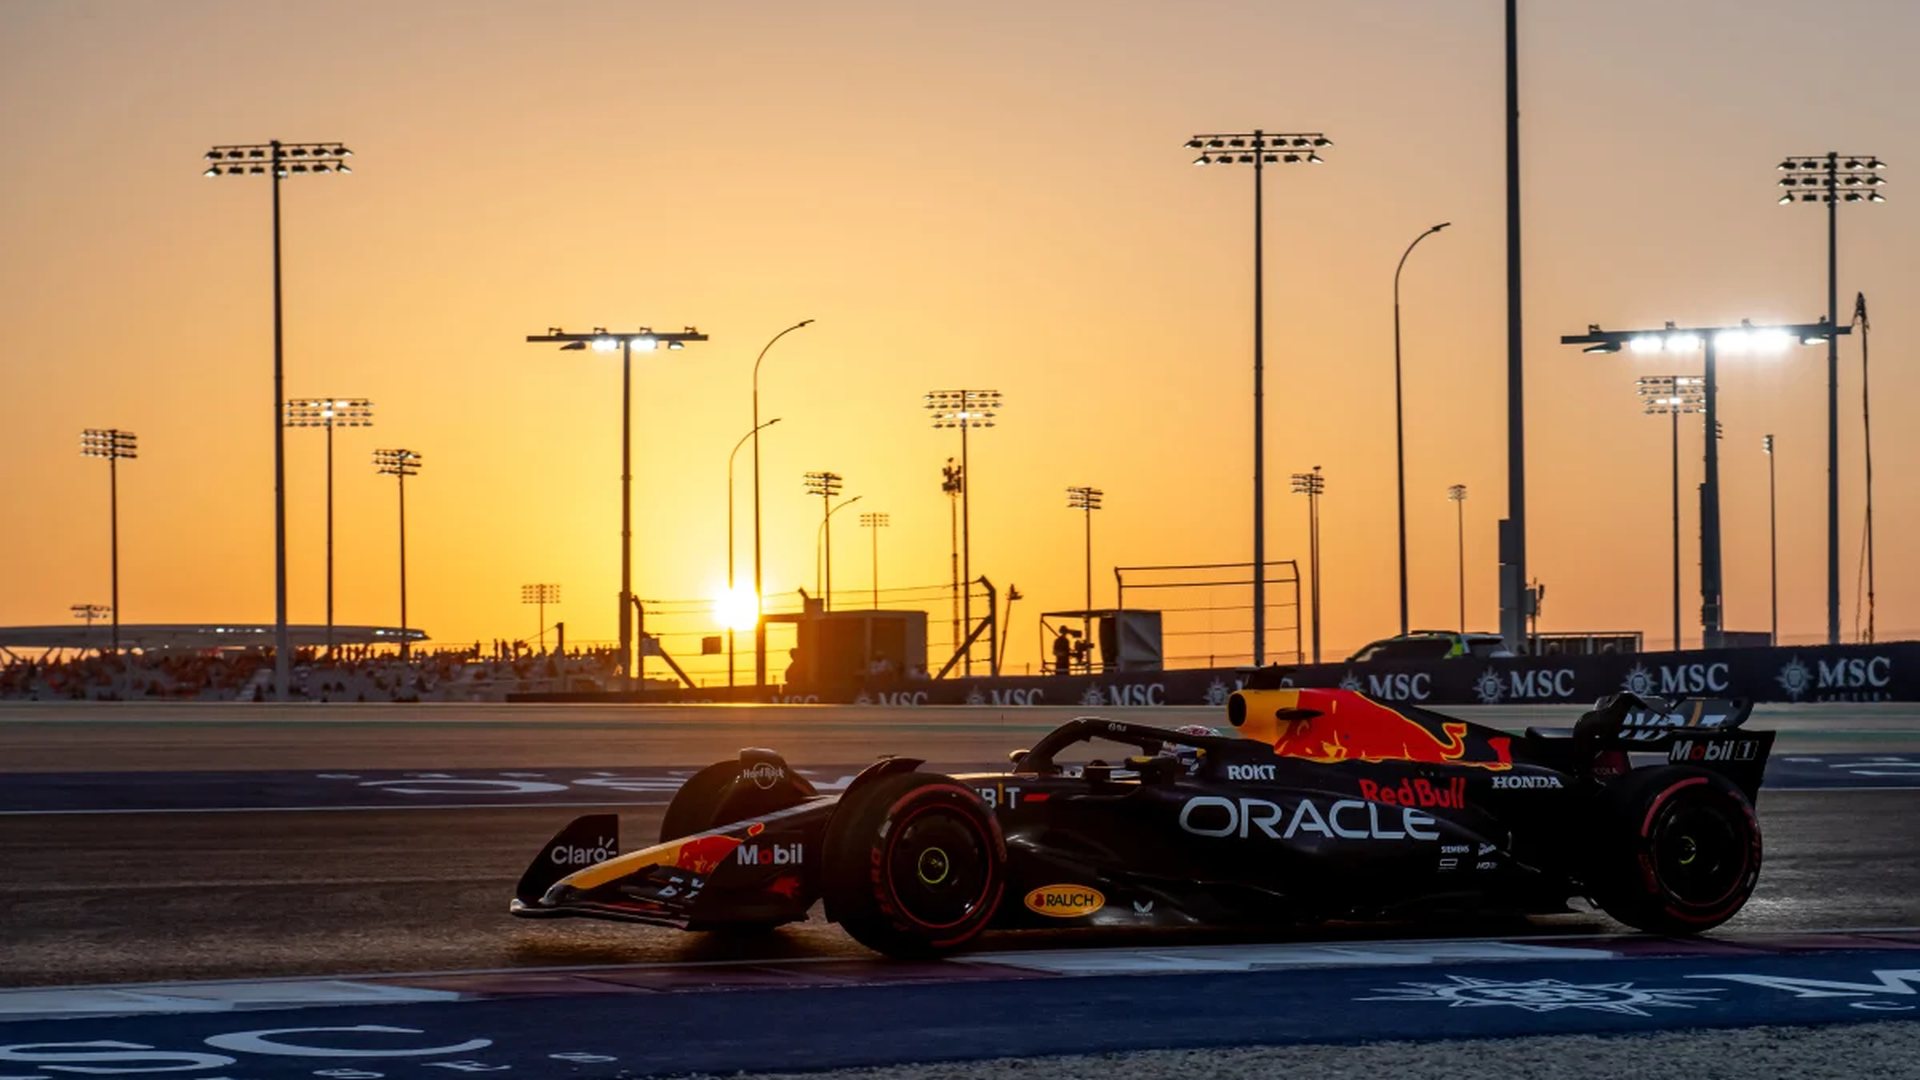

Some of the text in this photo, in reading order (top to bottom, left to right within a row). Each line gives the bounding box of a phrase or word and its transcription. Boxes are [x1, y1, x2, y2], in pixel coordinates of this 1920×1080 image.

[1509, 669, 1575, 698] MSC
[1660, 663, 1729, 694] MSC
[1817, 656, 1891, 688] MSC
[1108, 683, 1165, 706] MSC
[1368, 673, 1431, 700] MSC
[1669, 739, 1734, 761] Mobil
[1227, 764, 1276, 781] ROKT
[1491, 775, 1564, 790] HONDA
[1178, 795, 1441, 841] ORACLE
[550, 843, 608, 865] Claro
[737, 842, 803, 866] Mobil
[1046, 893, 1094, 907] RAUCH
